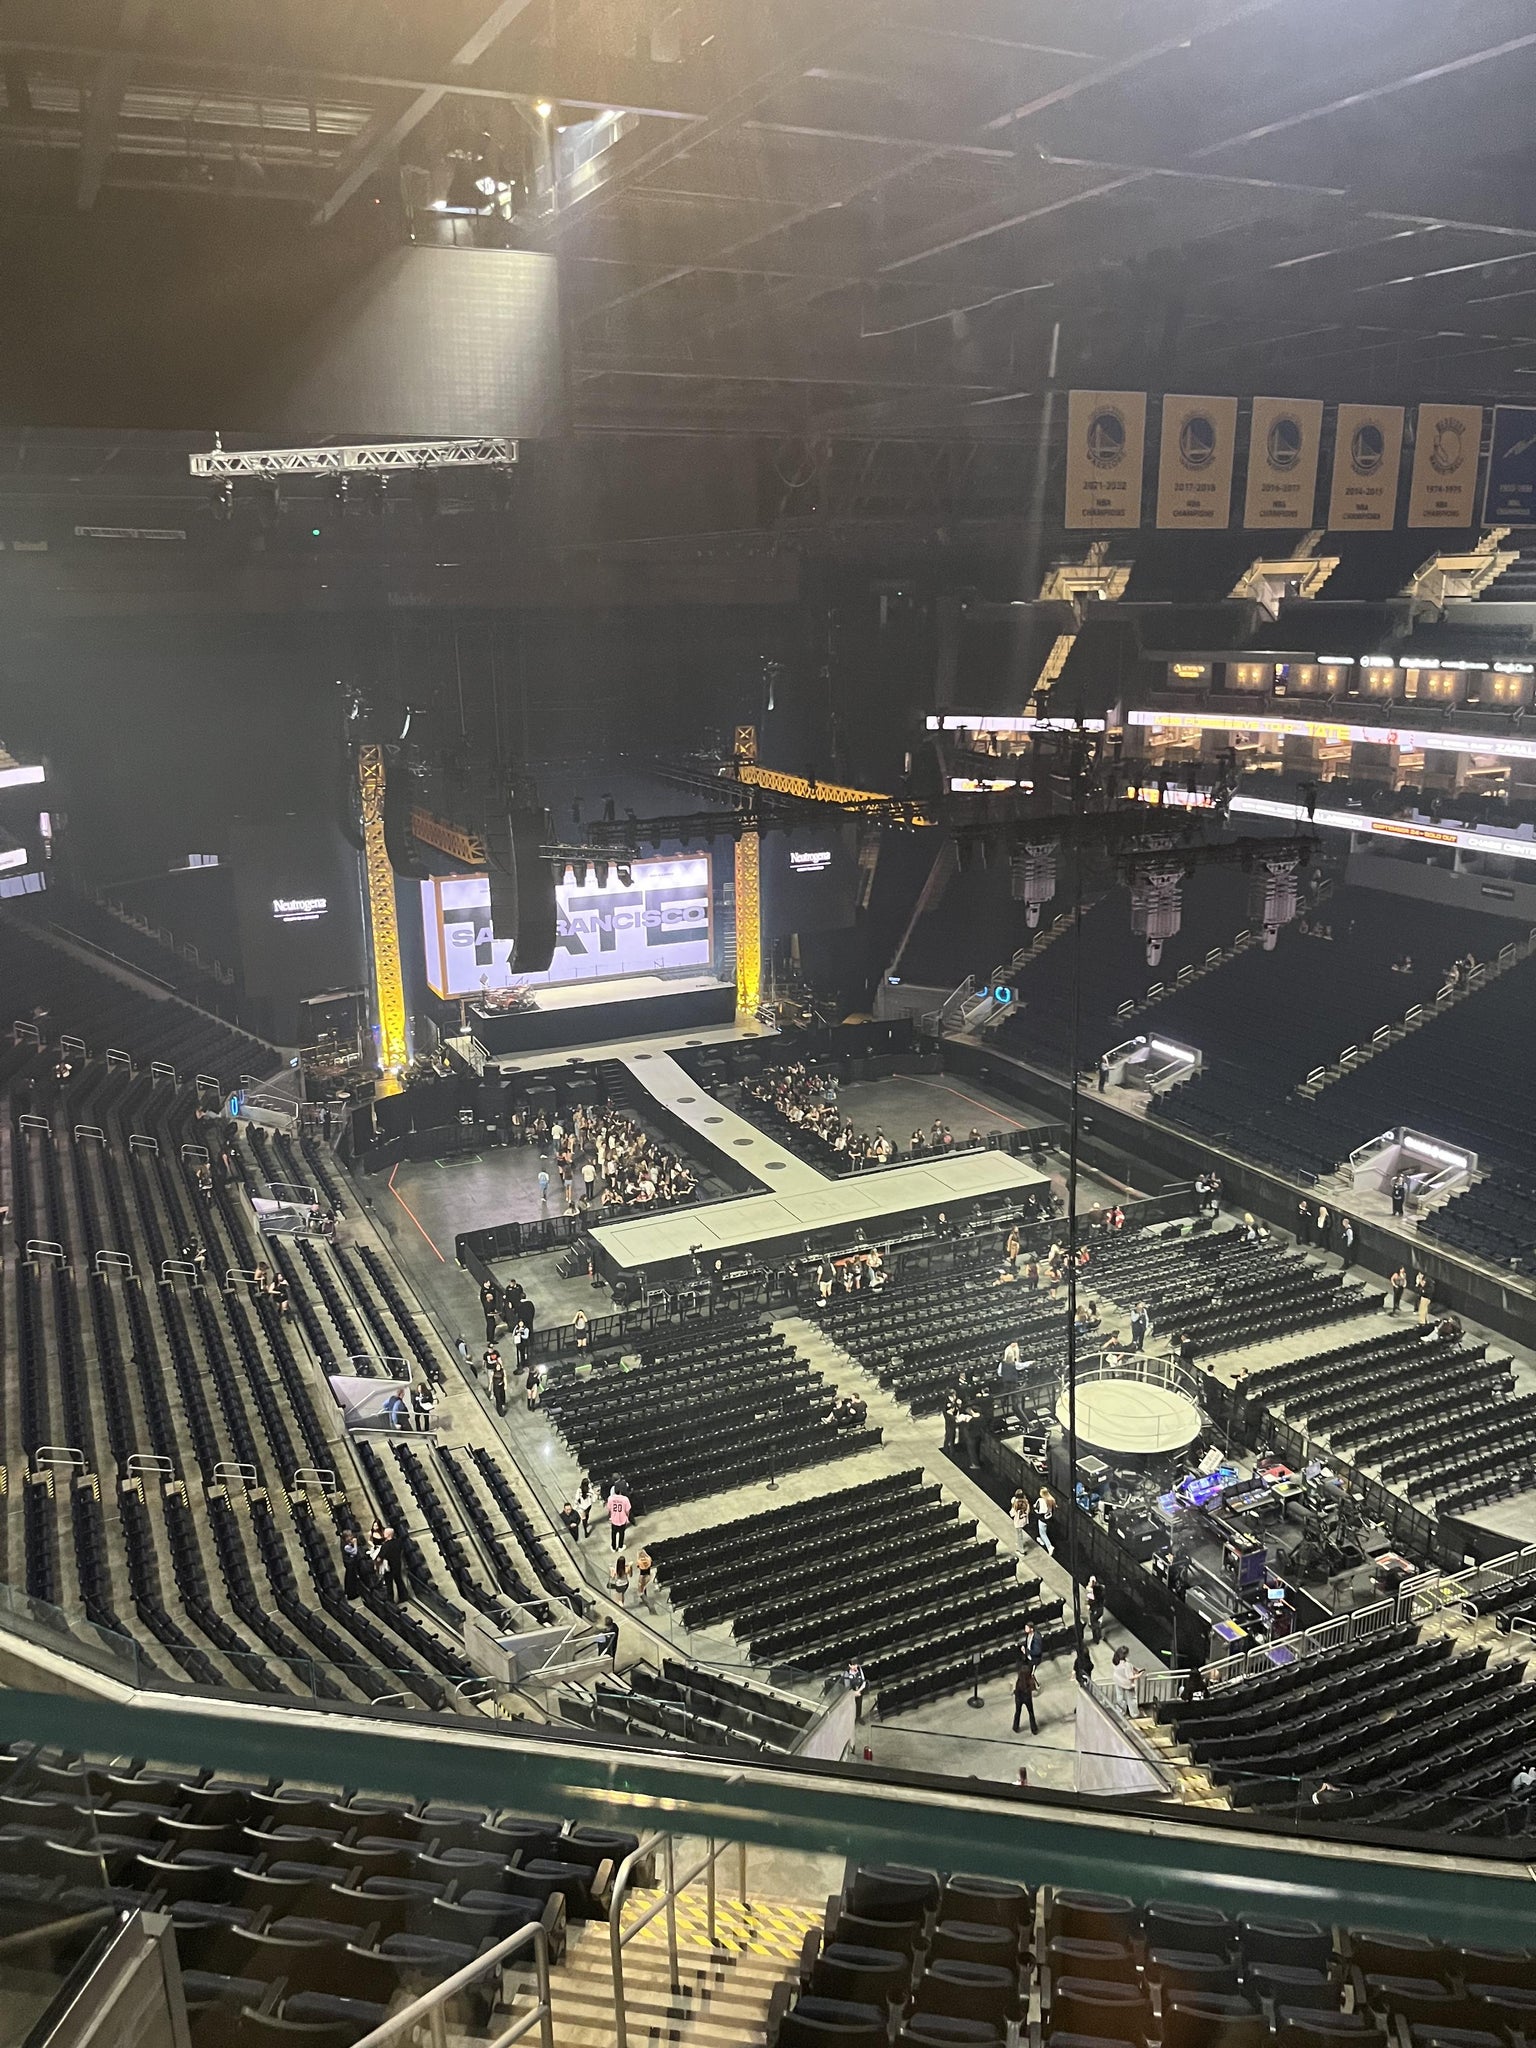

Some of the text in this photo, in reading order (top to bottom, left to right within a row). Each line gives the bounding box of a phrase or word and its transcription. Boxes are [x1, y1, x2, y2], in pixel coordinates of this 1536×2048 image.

[1305, 721, 1351, 740] TATE
[1372, 823, 1409, 834] SEPTEMBER
[1424, 831, 1442, 840] SOLD
[1442, 834, 1457, 842] OUT
[1468, 838, 1502, 850] CHASE
[790, 852, 831, 864] Neutrogena
[273, 898, 327, 912] Neutrogena
[452, 905, 706, 948] SA RANCISCO
[612, 1503, 623, 1513] 20
